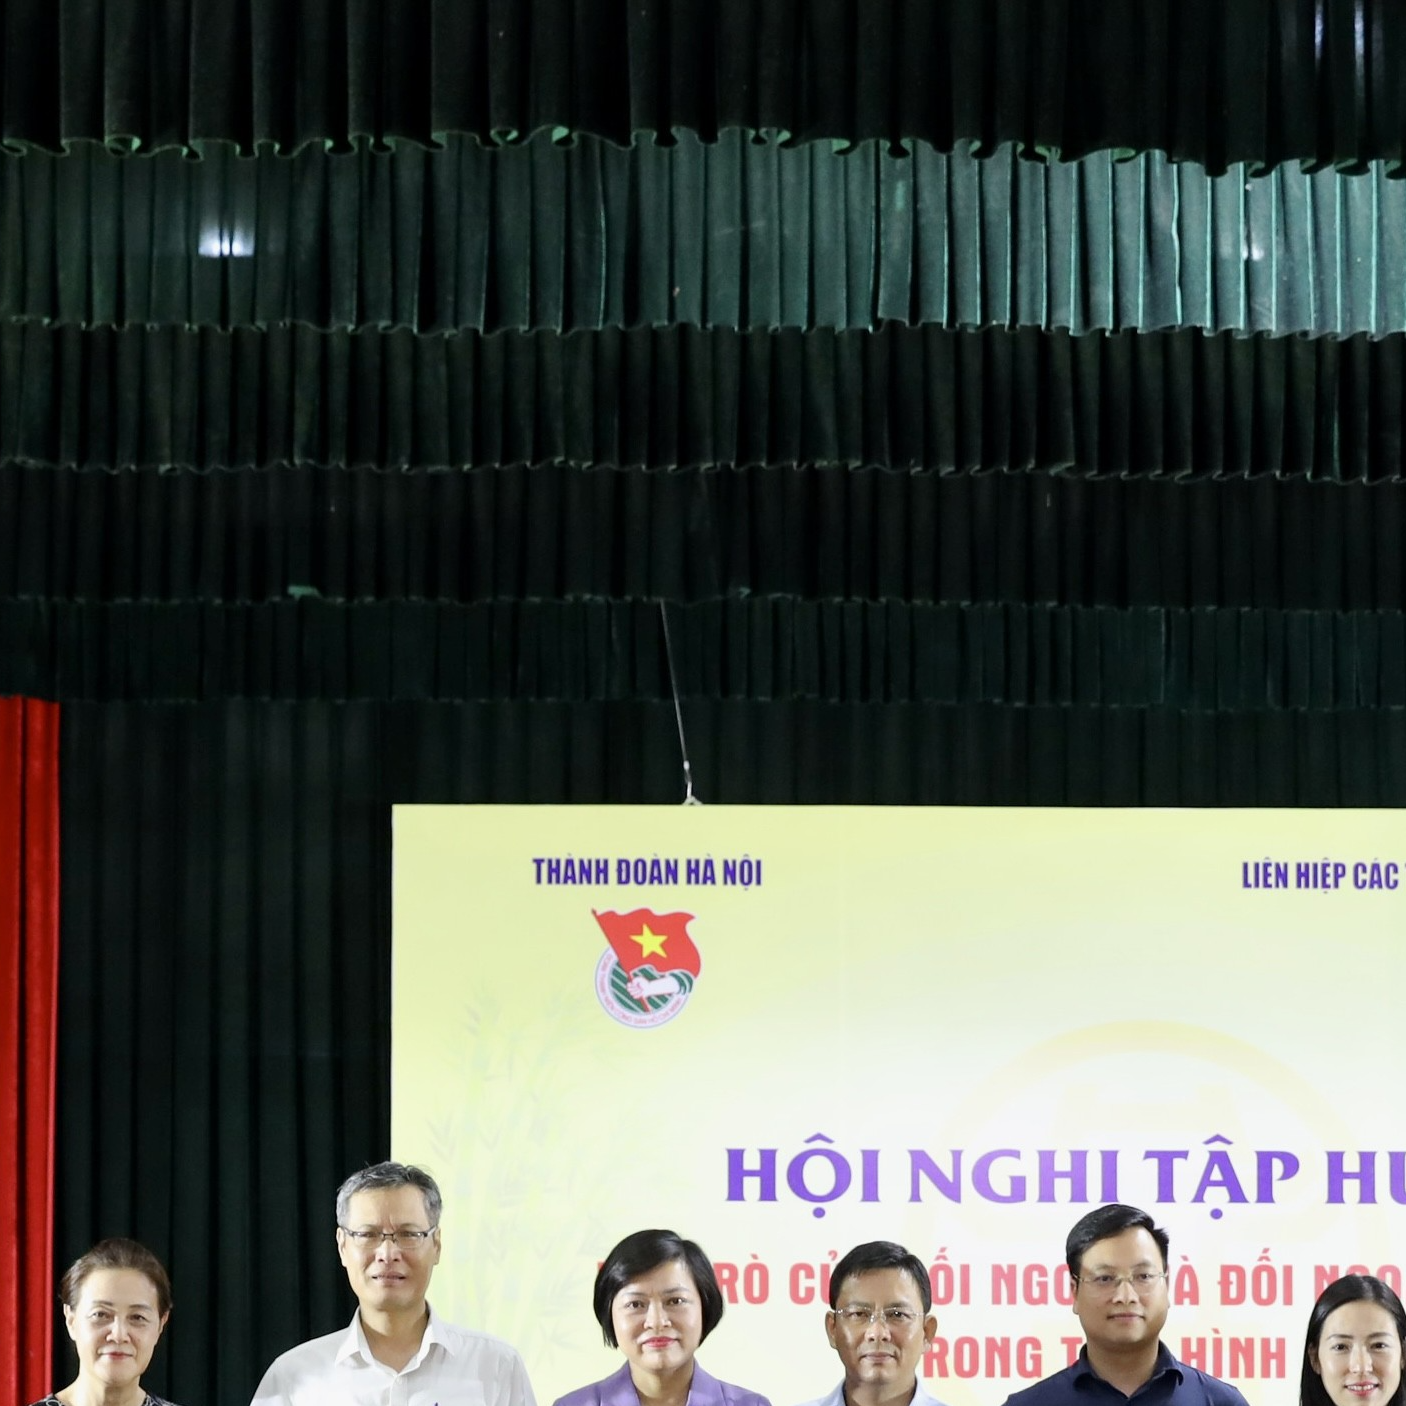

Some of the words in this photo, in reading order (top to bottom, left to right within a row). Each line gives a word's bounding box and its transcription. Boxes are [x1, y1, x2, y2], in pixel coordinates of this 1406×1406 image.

[533, 855, 609, 886] THÀNH
[616, 855, 680, 887] ĐOÀN
[686, 855, 717, 886] HÀ
[723, 853, 763, 893] NỘI
[1242, 857, 1290, 890] LIÊN
[1296, 857, 1348, 894] HIỆP
[1353, 857, 1400, 890] CÁC
[726, 1132, 881, 1220] HỘI
[1142, 1133, 1302, 1221] TẬP
[713, 1254, 770, 1305] RÒ
[931, 1247, 971, 1306] ỐI
[991, 1263, 1076, 1306] NGO
[1167, 1255, 1200, 1306] À
[1218, 1248, 1294, 1307] ĐỐI
[923, 1336, 1043, 1380] RONG
[1181, 1328, 1287, 1380] HÌNH
